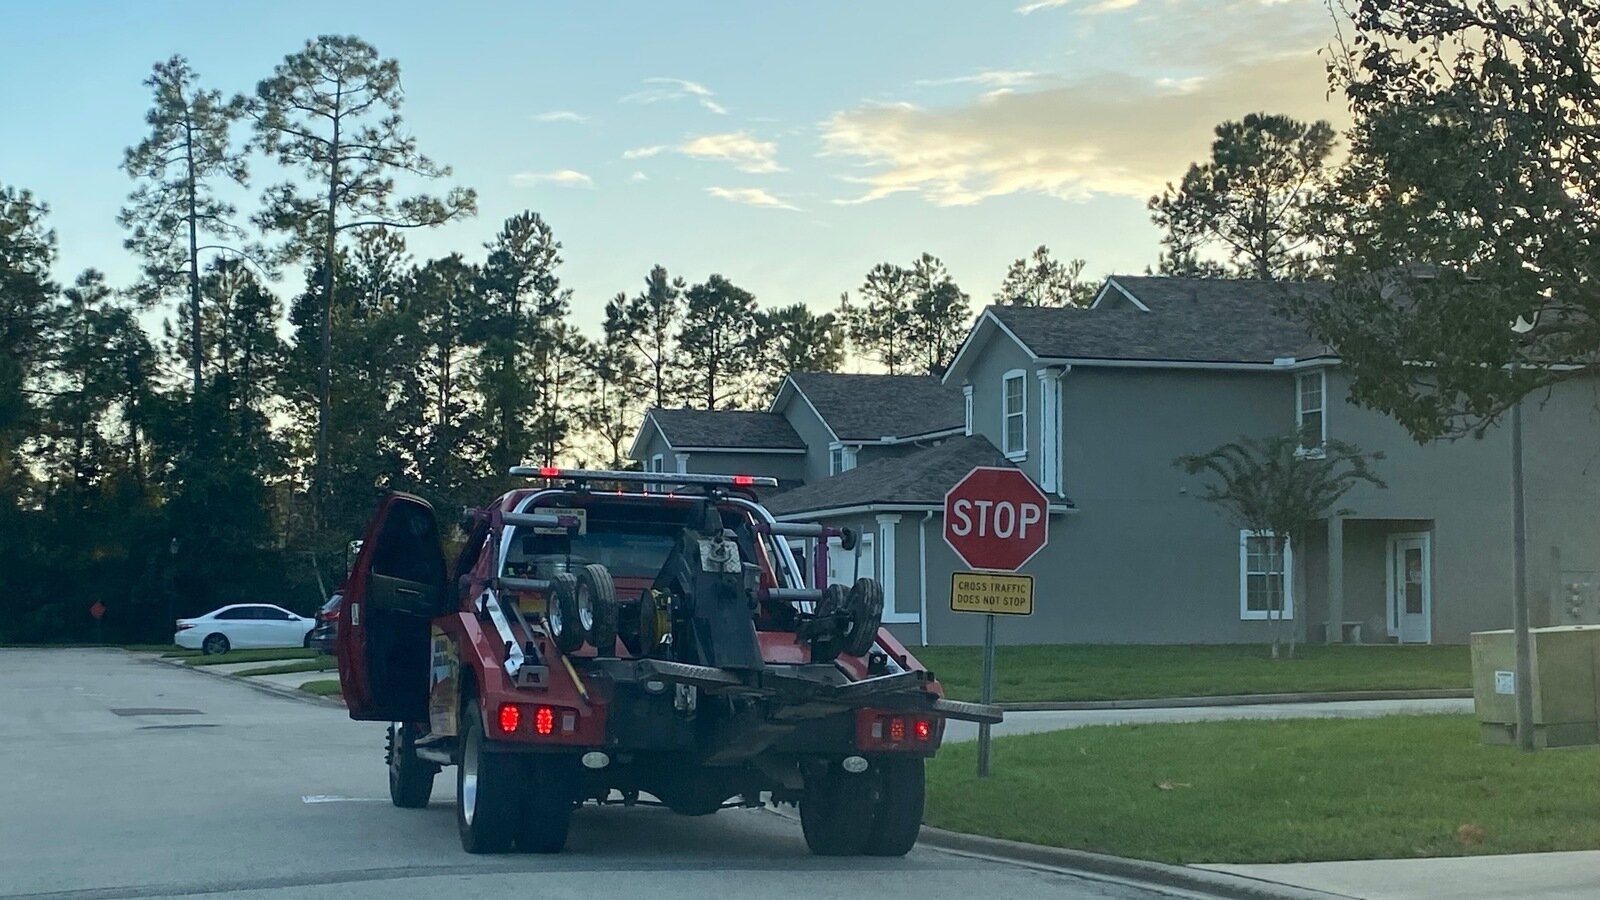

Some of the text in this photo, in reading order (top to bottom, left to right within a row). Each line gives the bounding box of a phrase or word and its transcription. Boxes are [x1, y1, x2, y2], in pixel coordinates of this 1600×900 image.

[951, 498, 1041, 540] STOP
[958, 581, 1027, 594] CROSS TRAFFIC
[957, 594, 1026, 607] DOES NOT STOP
